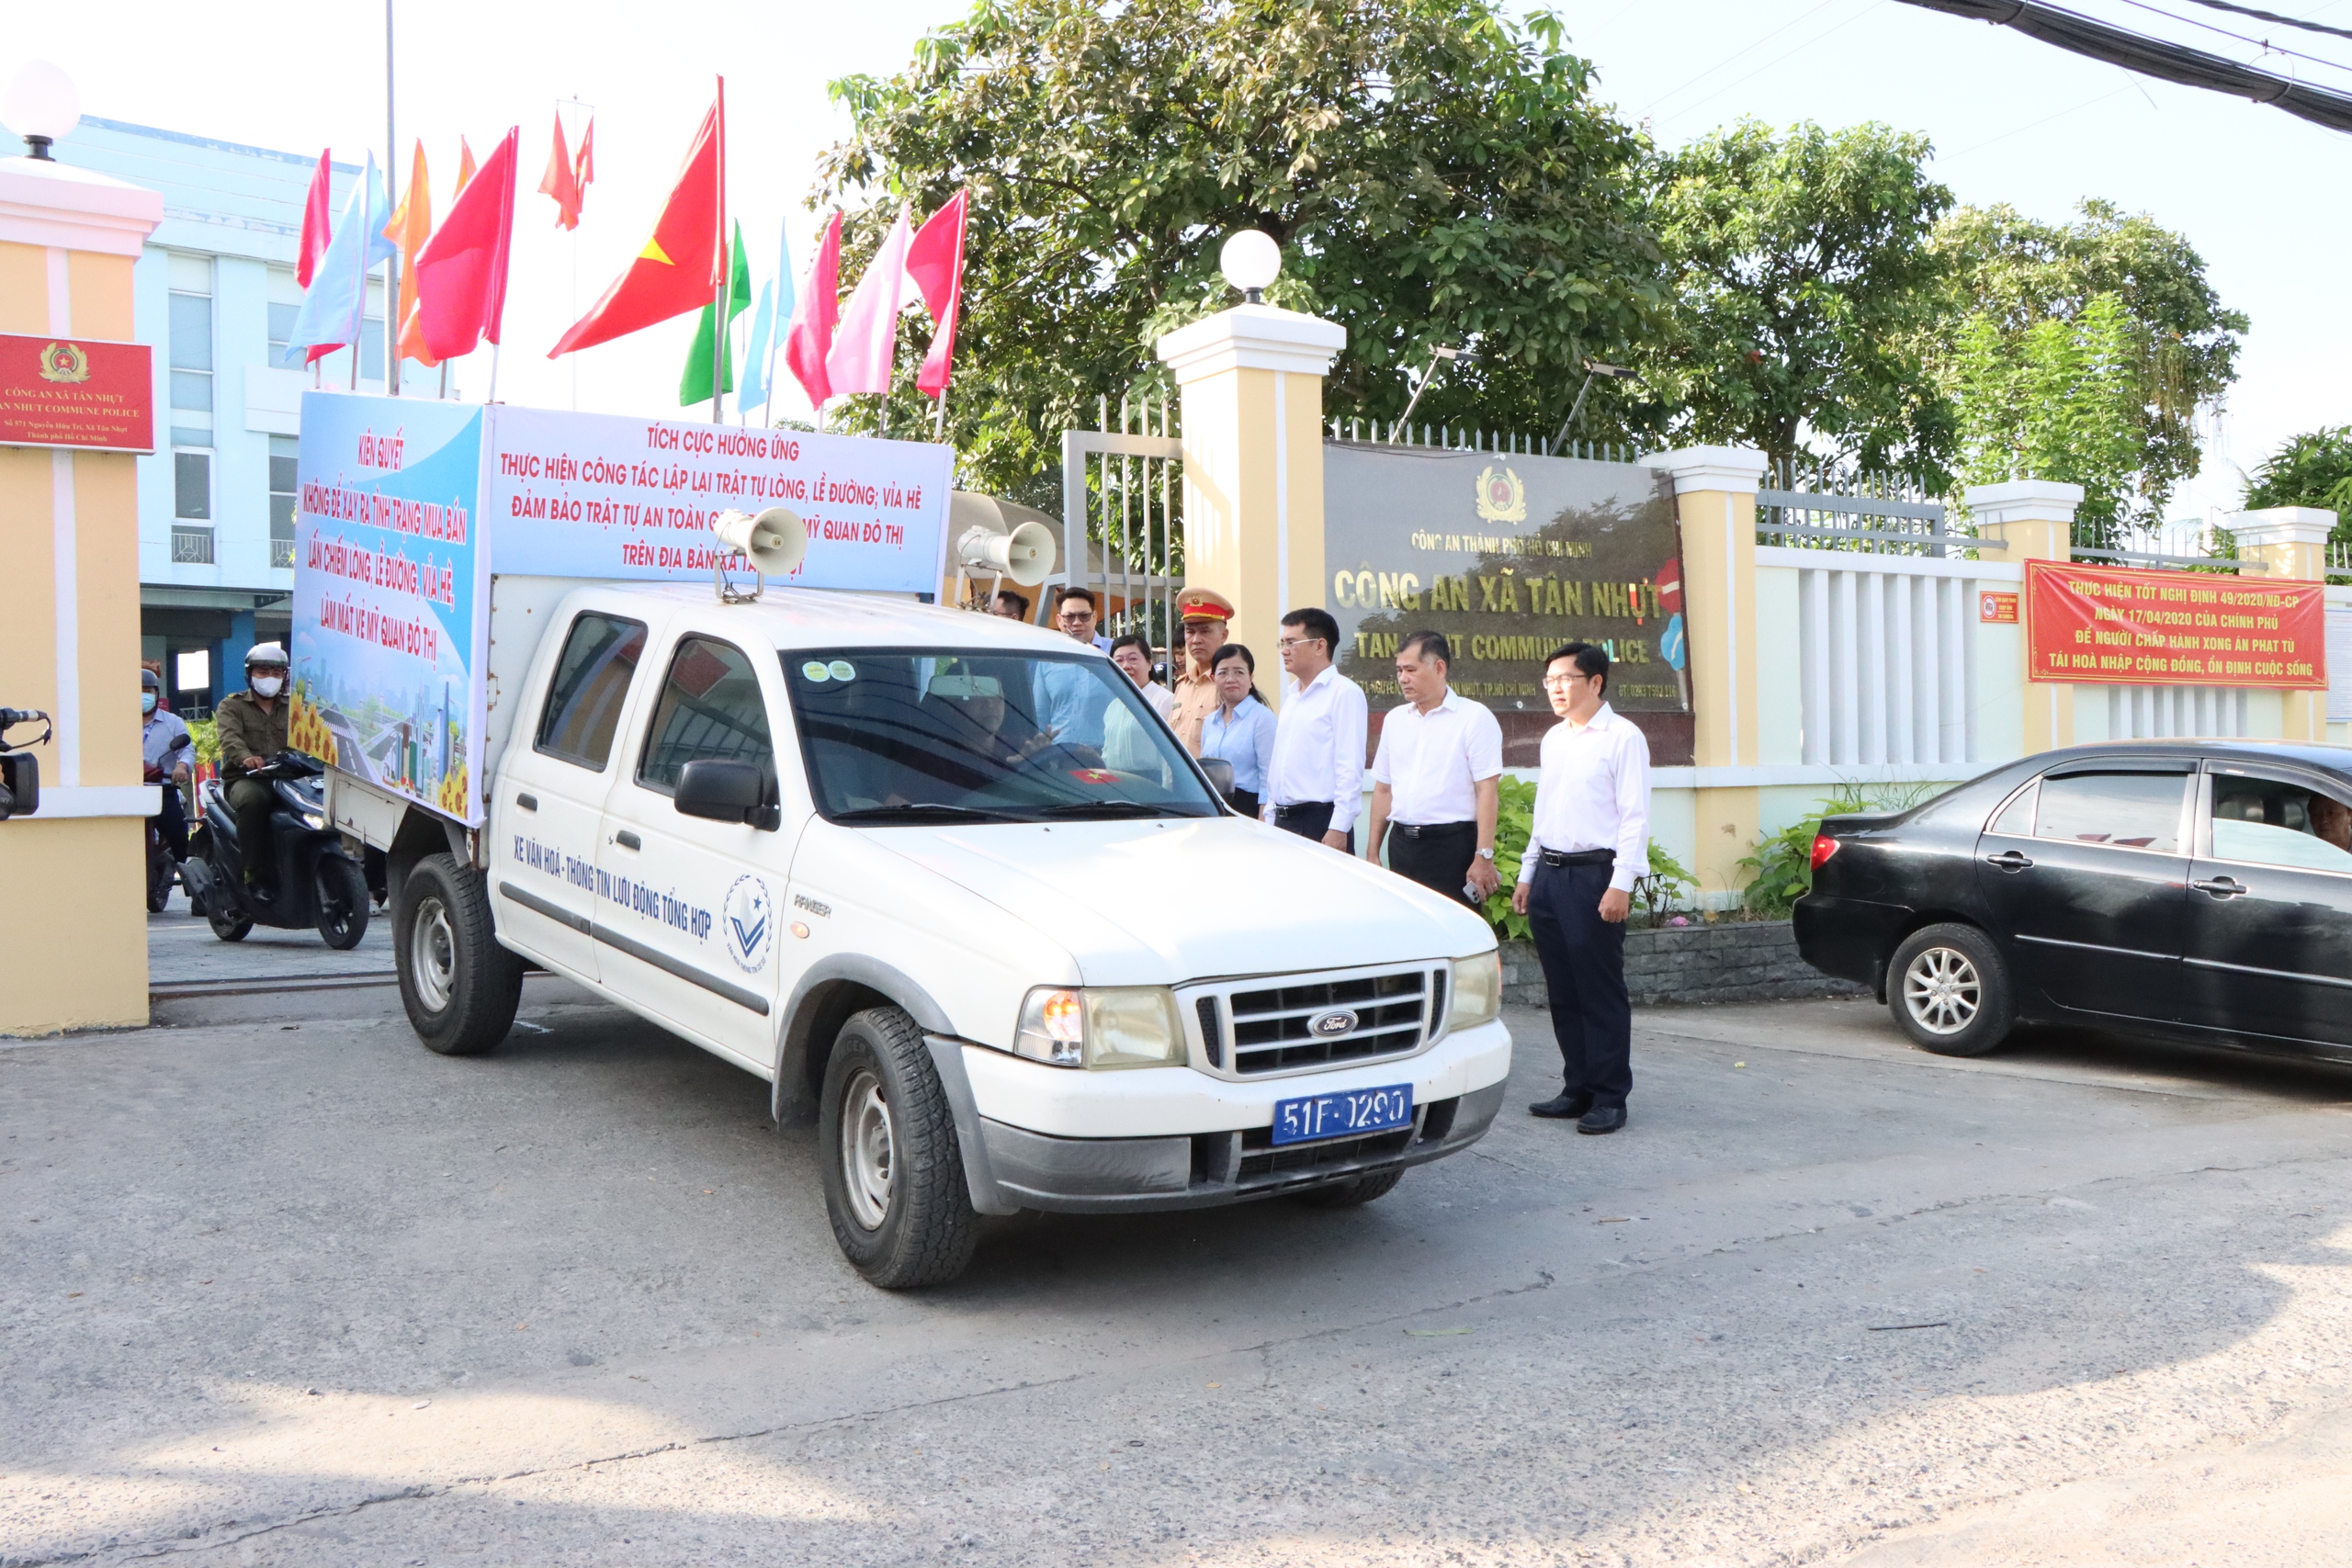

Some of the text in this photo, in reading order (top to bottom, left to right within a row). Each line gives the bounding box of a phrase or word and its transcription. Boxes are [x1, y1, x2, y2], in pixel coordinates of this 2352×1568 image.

[5, 387, 124, 404] CÔNG AN XÃ TÂN NHỰT
[14, 402, 43, 412] NHUT
[45, 405, 99, 415] COMMUNE
[102, 408, 140, 418] POLICE
[358, 424, 404, 471] KIÊN QUYẾT
[648, 422, 799, 461] TÍCH CỰC HƯỞNG ỨNG
[501, 452, 922, 511] THỰC HIỆN CÔNG TÁC LẬP LẠI TRẬT TỰ LÒNG, LỀ ĐƯỜNG; VỈA HÈ
[303, 473, 468, 544] KHÔNG ĐỂ XẢY RA TÌNH TRẠNG MUA BÁN
[511, 488, 546, 519] ĐẢM
[550, 491, 582, 523] BẢO
[586, 497, 619, 530] TRẬT
[624, 502, 640, 533] TỰ
[642, 506, 663, 528] AN
[668, 503, 705, 531] TOÀN
[823, 519, 860, 543] QUAN
[863, 518, 882, 544] ĐÔ
[885, 524, 904, 551] THỊ
[622, 539, 655, 567] TRÊN
[659, 547, 683, 574] ĐỊA
[686, 543, 715, 570] BÀN
[1411, 529, 1442, 551] CÔNG
[1445, 535, 1461, 551] AN
[1463, 533, 1499, 555] THÀNH
[1566, 540, 1592, 558] MINH
[308, 528, 322, 570] LẤN
[323, 532, 347, 577] CHIẾM
[422, 555, 437, 600] VỈA
[1334, 561, 1662, 626] CÔNG AN XÃ TÂN NHỰT
[2068, 581, 2300, 608] THỰC HIỆN TỐT NGHỊ ĐỊNH 49/2020/NĐ-CP
[321, 591, 336, 630] LÀM
[337, 592, 354, 636] MẤT
[356, 599, 366, 639] VẺ
[381, 615, 405, 651] QUAN
[407, 615, 421, 656] ĐÔ
[423, 626, 437, 671] THỊ
[2095, 605, 2278, 630] NGÀY 17/04/2020 CỦA CHÍNH PHỦ
[1354, 633, 1398, 659] TAN
[1471, 634, 1573, 661] COMMUN
[1582, 637, 1650, 663] LICE
[2075, 625, 2295, 655] ĐỂ NGƯỜI CHẤP HÀNH XONG ÁN PHẠT TÙ
[2049, 650, 2312, 677] TÁI HOÀ NHẬP CỘNG ĐỒNG, ỔN ĐỊNH CUỘC SỐNG
[514, 834, 711, 945] XE VĂN HOÁ THÔNG TIN LƯU ĐỘNG TỔNG HỢP
[794, 894, 831, 919] RANGER
[1323, 1017, 1347, 1031] Ford
